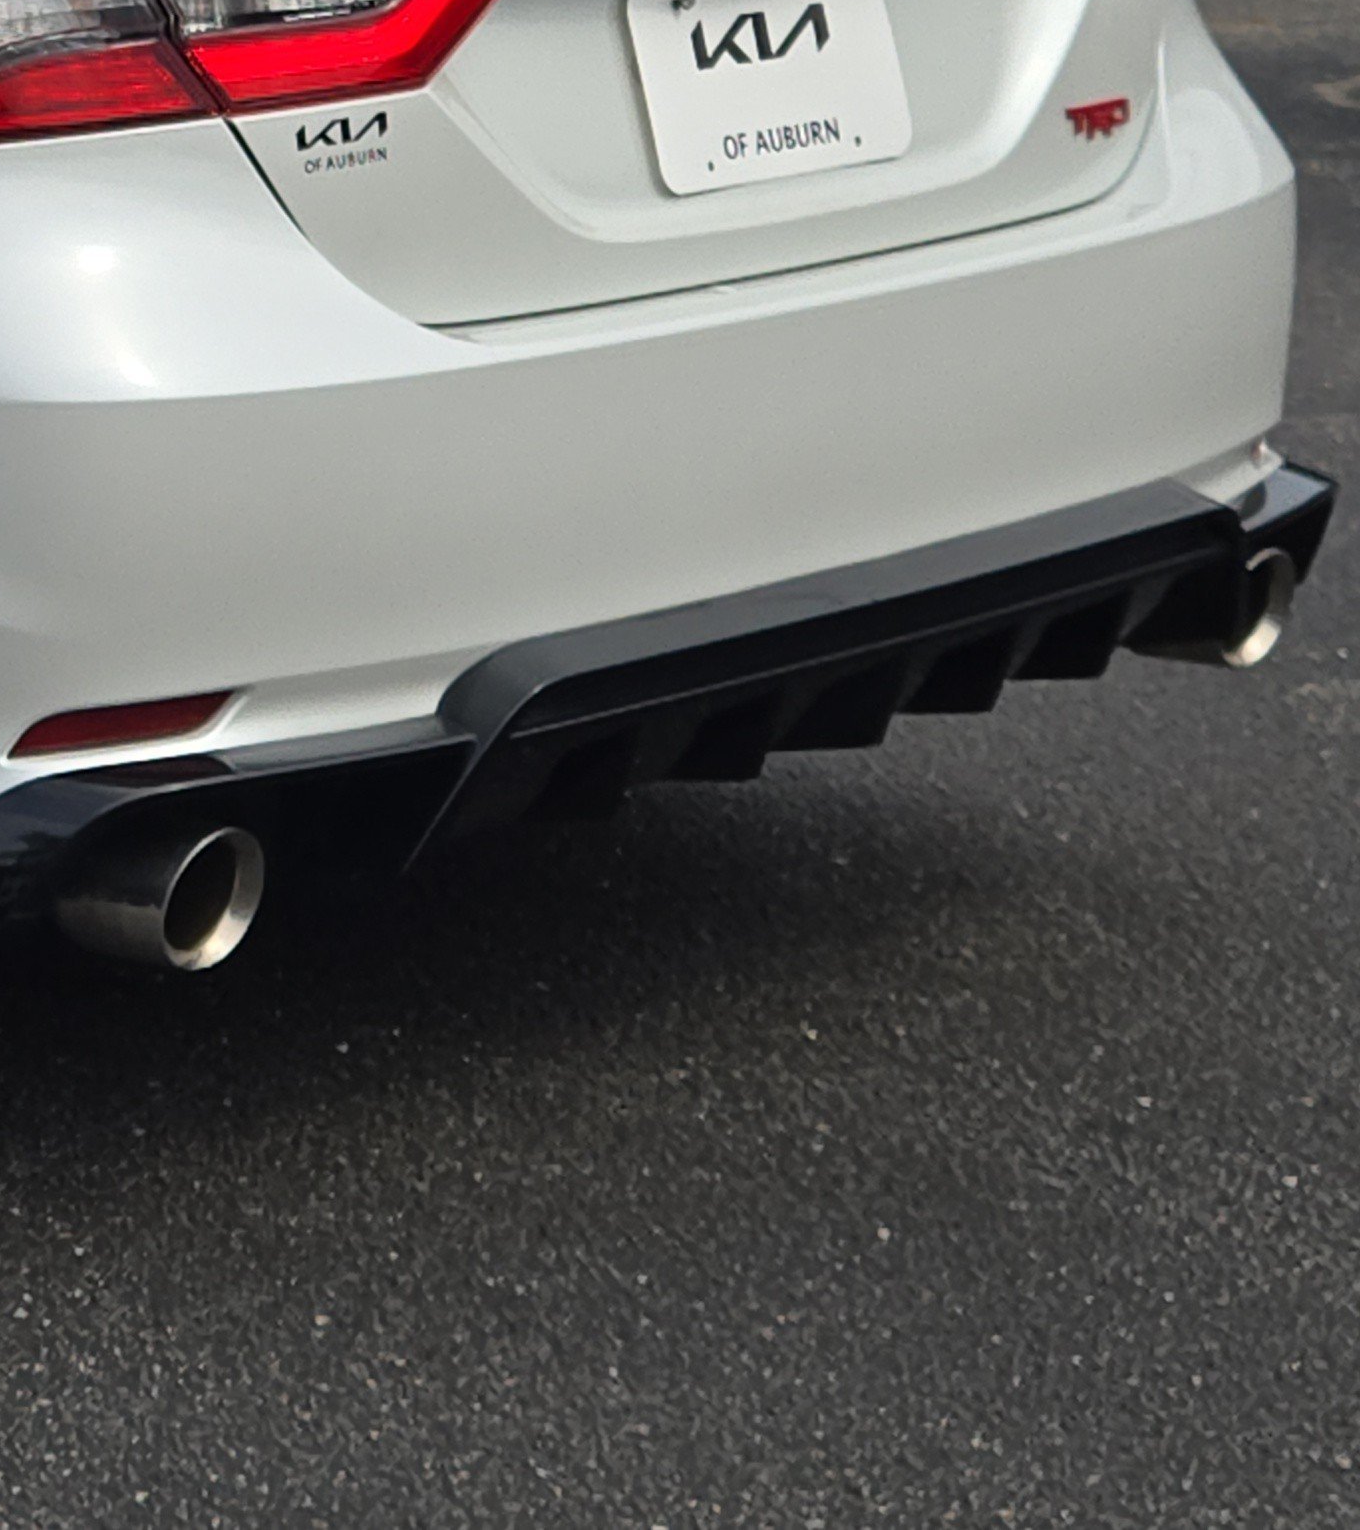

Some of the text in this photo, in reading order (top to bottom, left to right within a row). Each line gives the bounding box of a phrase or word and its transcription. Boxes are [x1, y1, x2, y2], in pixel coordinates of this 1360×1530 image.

[691, 3, 830, 70] KIA
[295, 111, 388, 151] KIA
[723, 118, 842, 160] OF AUBURN
[304, 147, 388, 174] OF AUBURN
